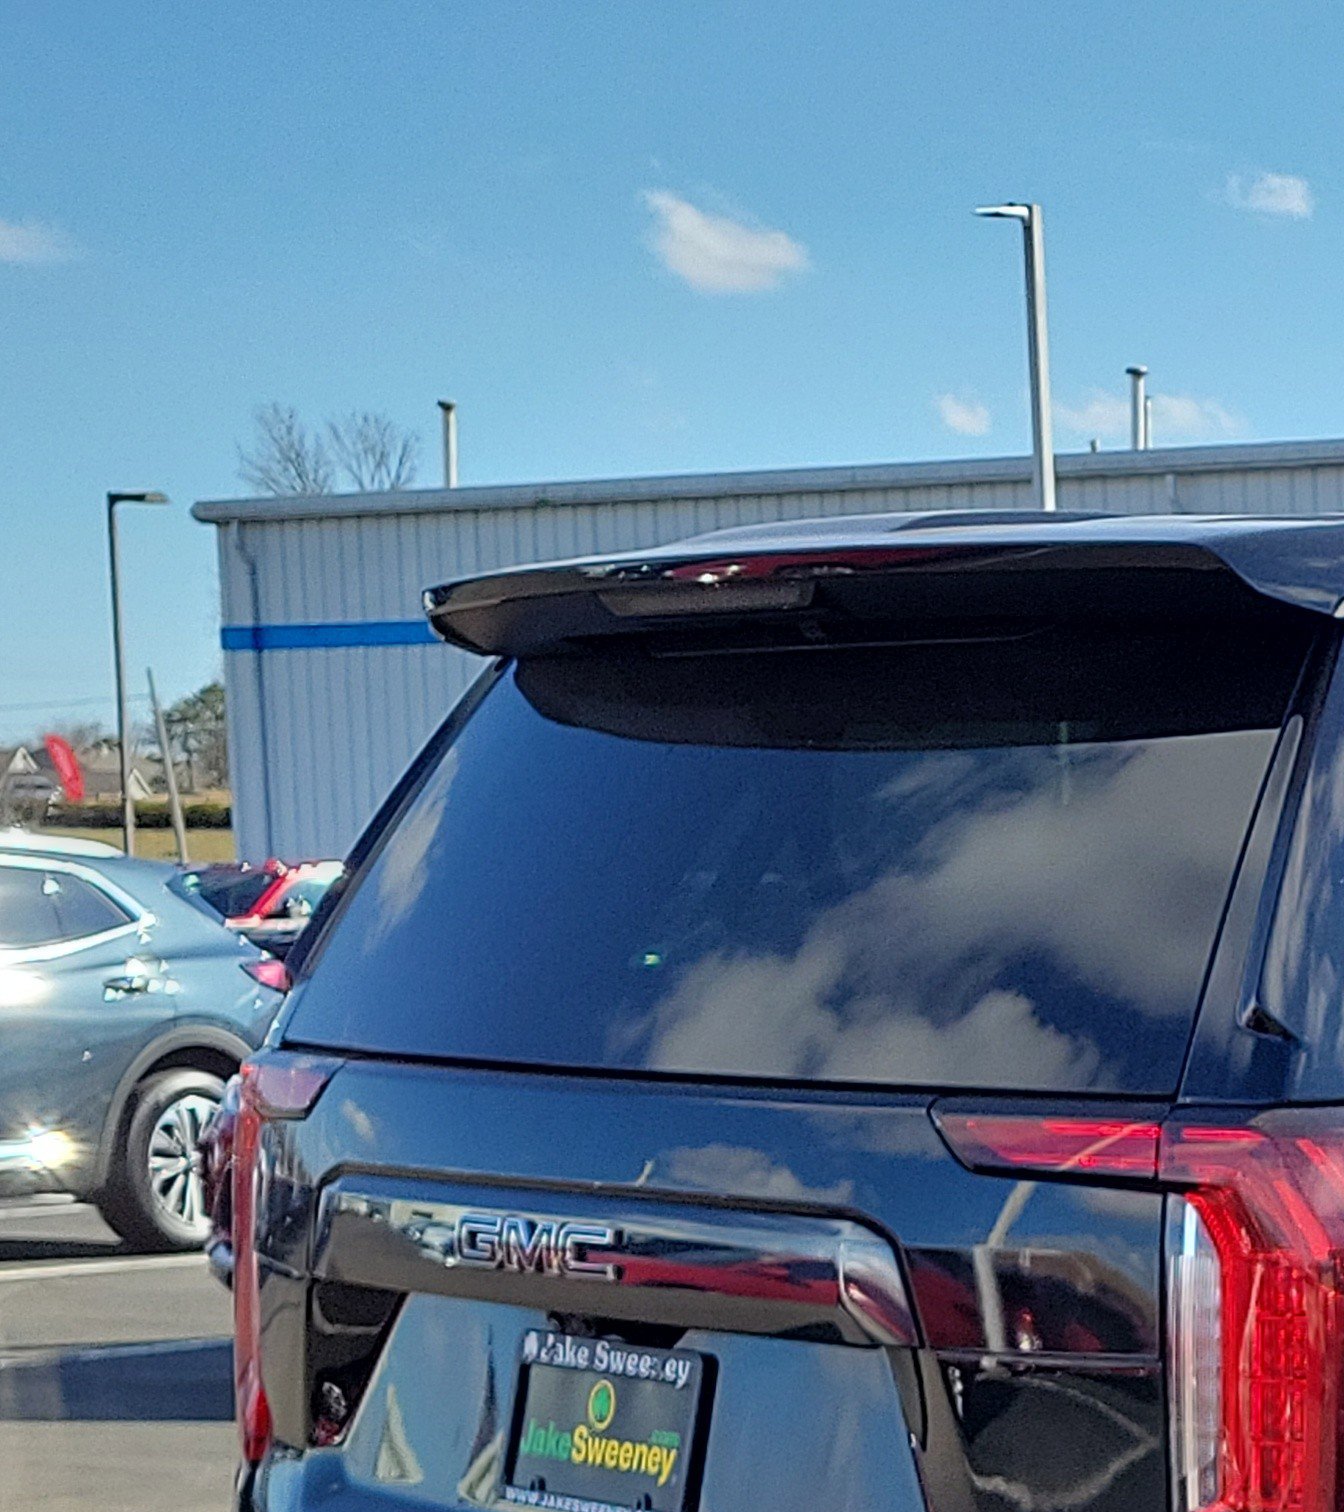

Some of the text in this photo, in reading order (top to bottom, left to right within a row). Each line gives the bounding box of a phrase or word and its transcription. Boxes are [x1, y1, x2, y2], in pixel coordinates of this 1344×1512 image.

[455, 1212, 618, 1282] GMC
[540, 1334, 690, 1390] Jake Sweeey
[521, 1417, 677, 1487] JakeSweeney
